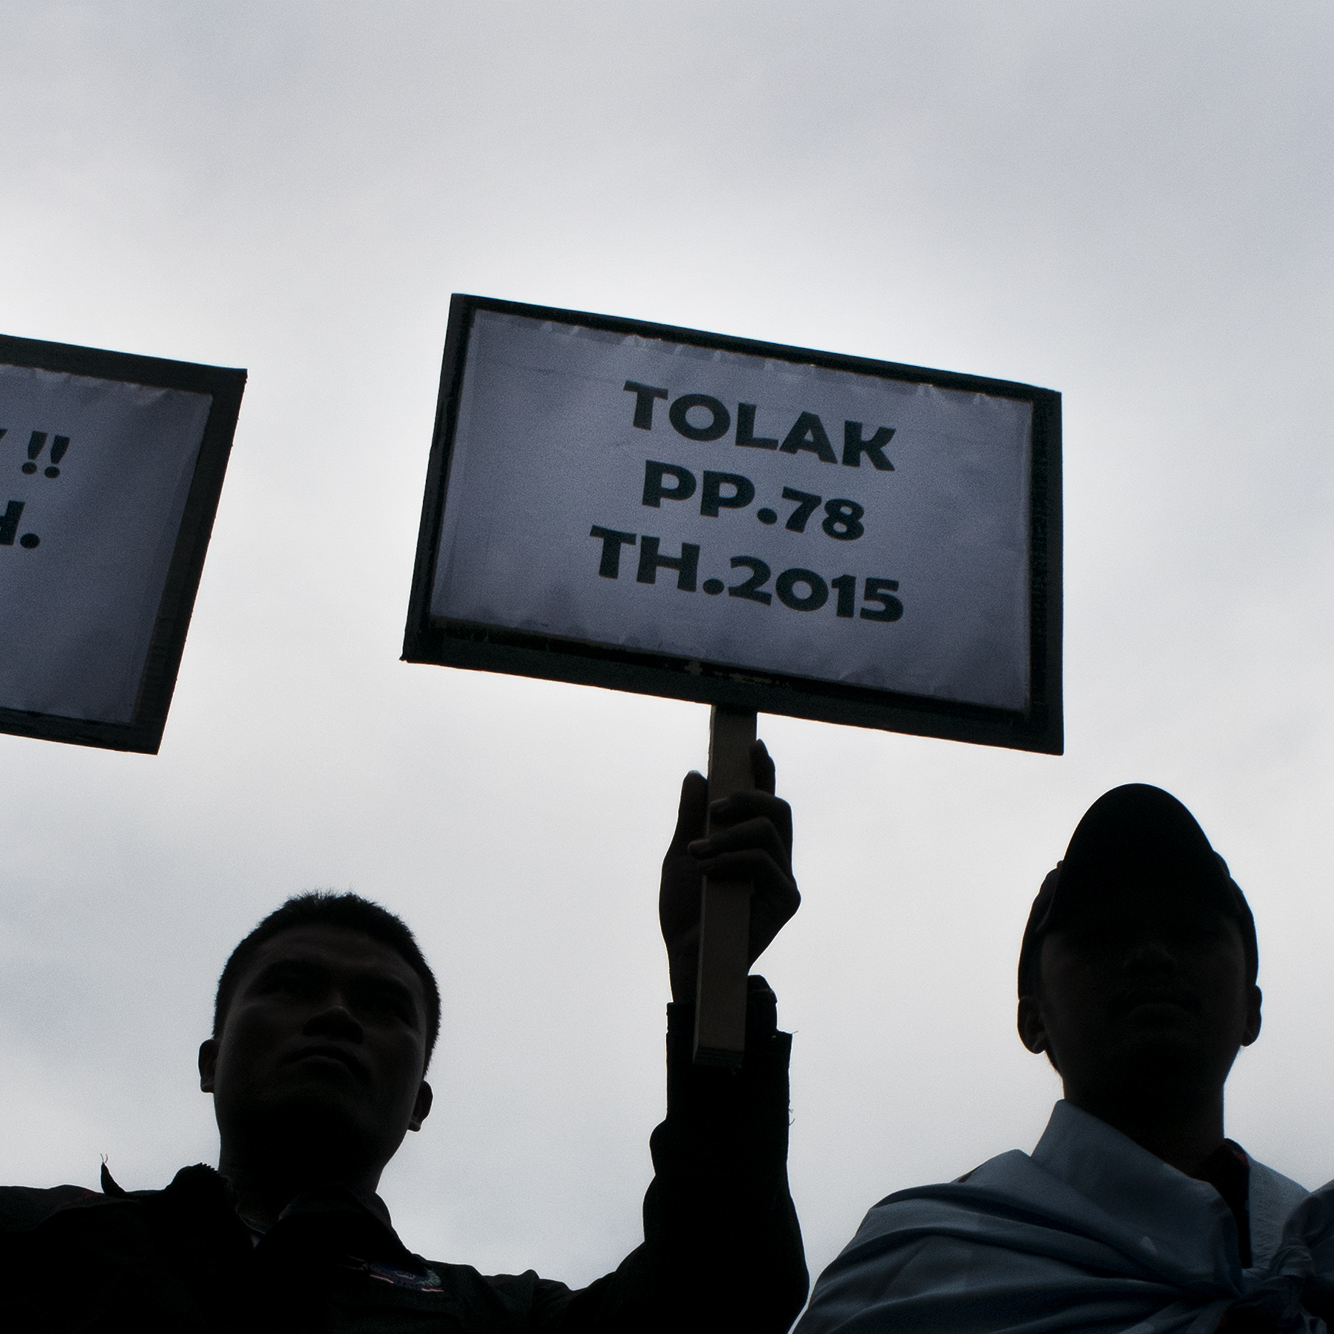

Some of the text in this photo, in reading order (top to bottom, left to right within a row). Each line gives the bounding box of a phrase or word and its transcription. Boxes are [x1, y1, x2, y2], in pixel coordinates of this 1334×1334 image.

[23, 432, 70, 479] !!
[624, 381, 895, 471] TOLAK
[642, 460, 865, 541] PP.78
[590, 525, 904, 623] TH.2015
